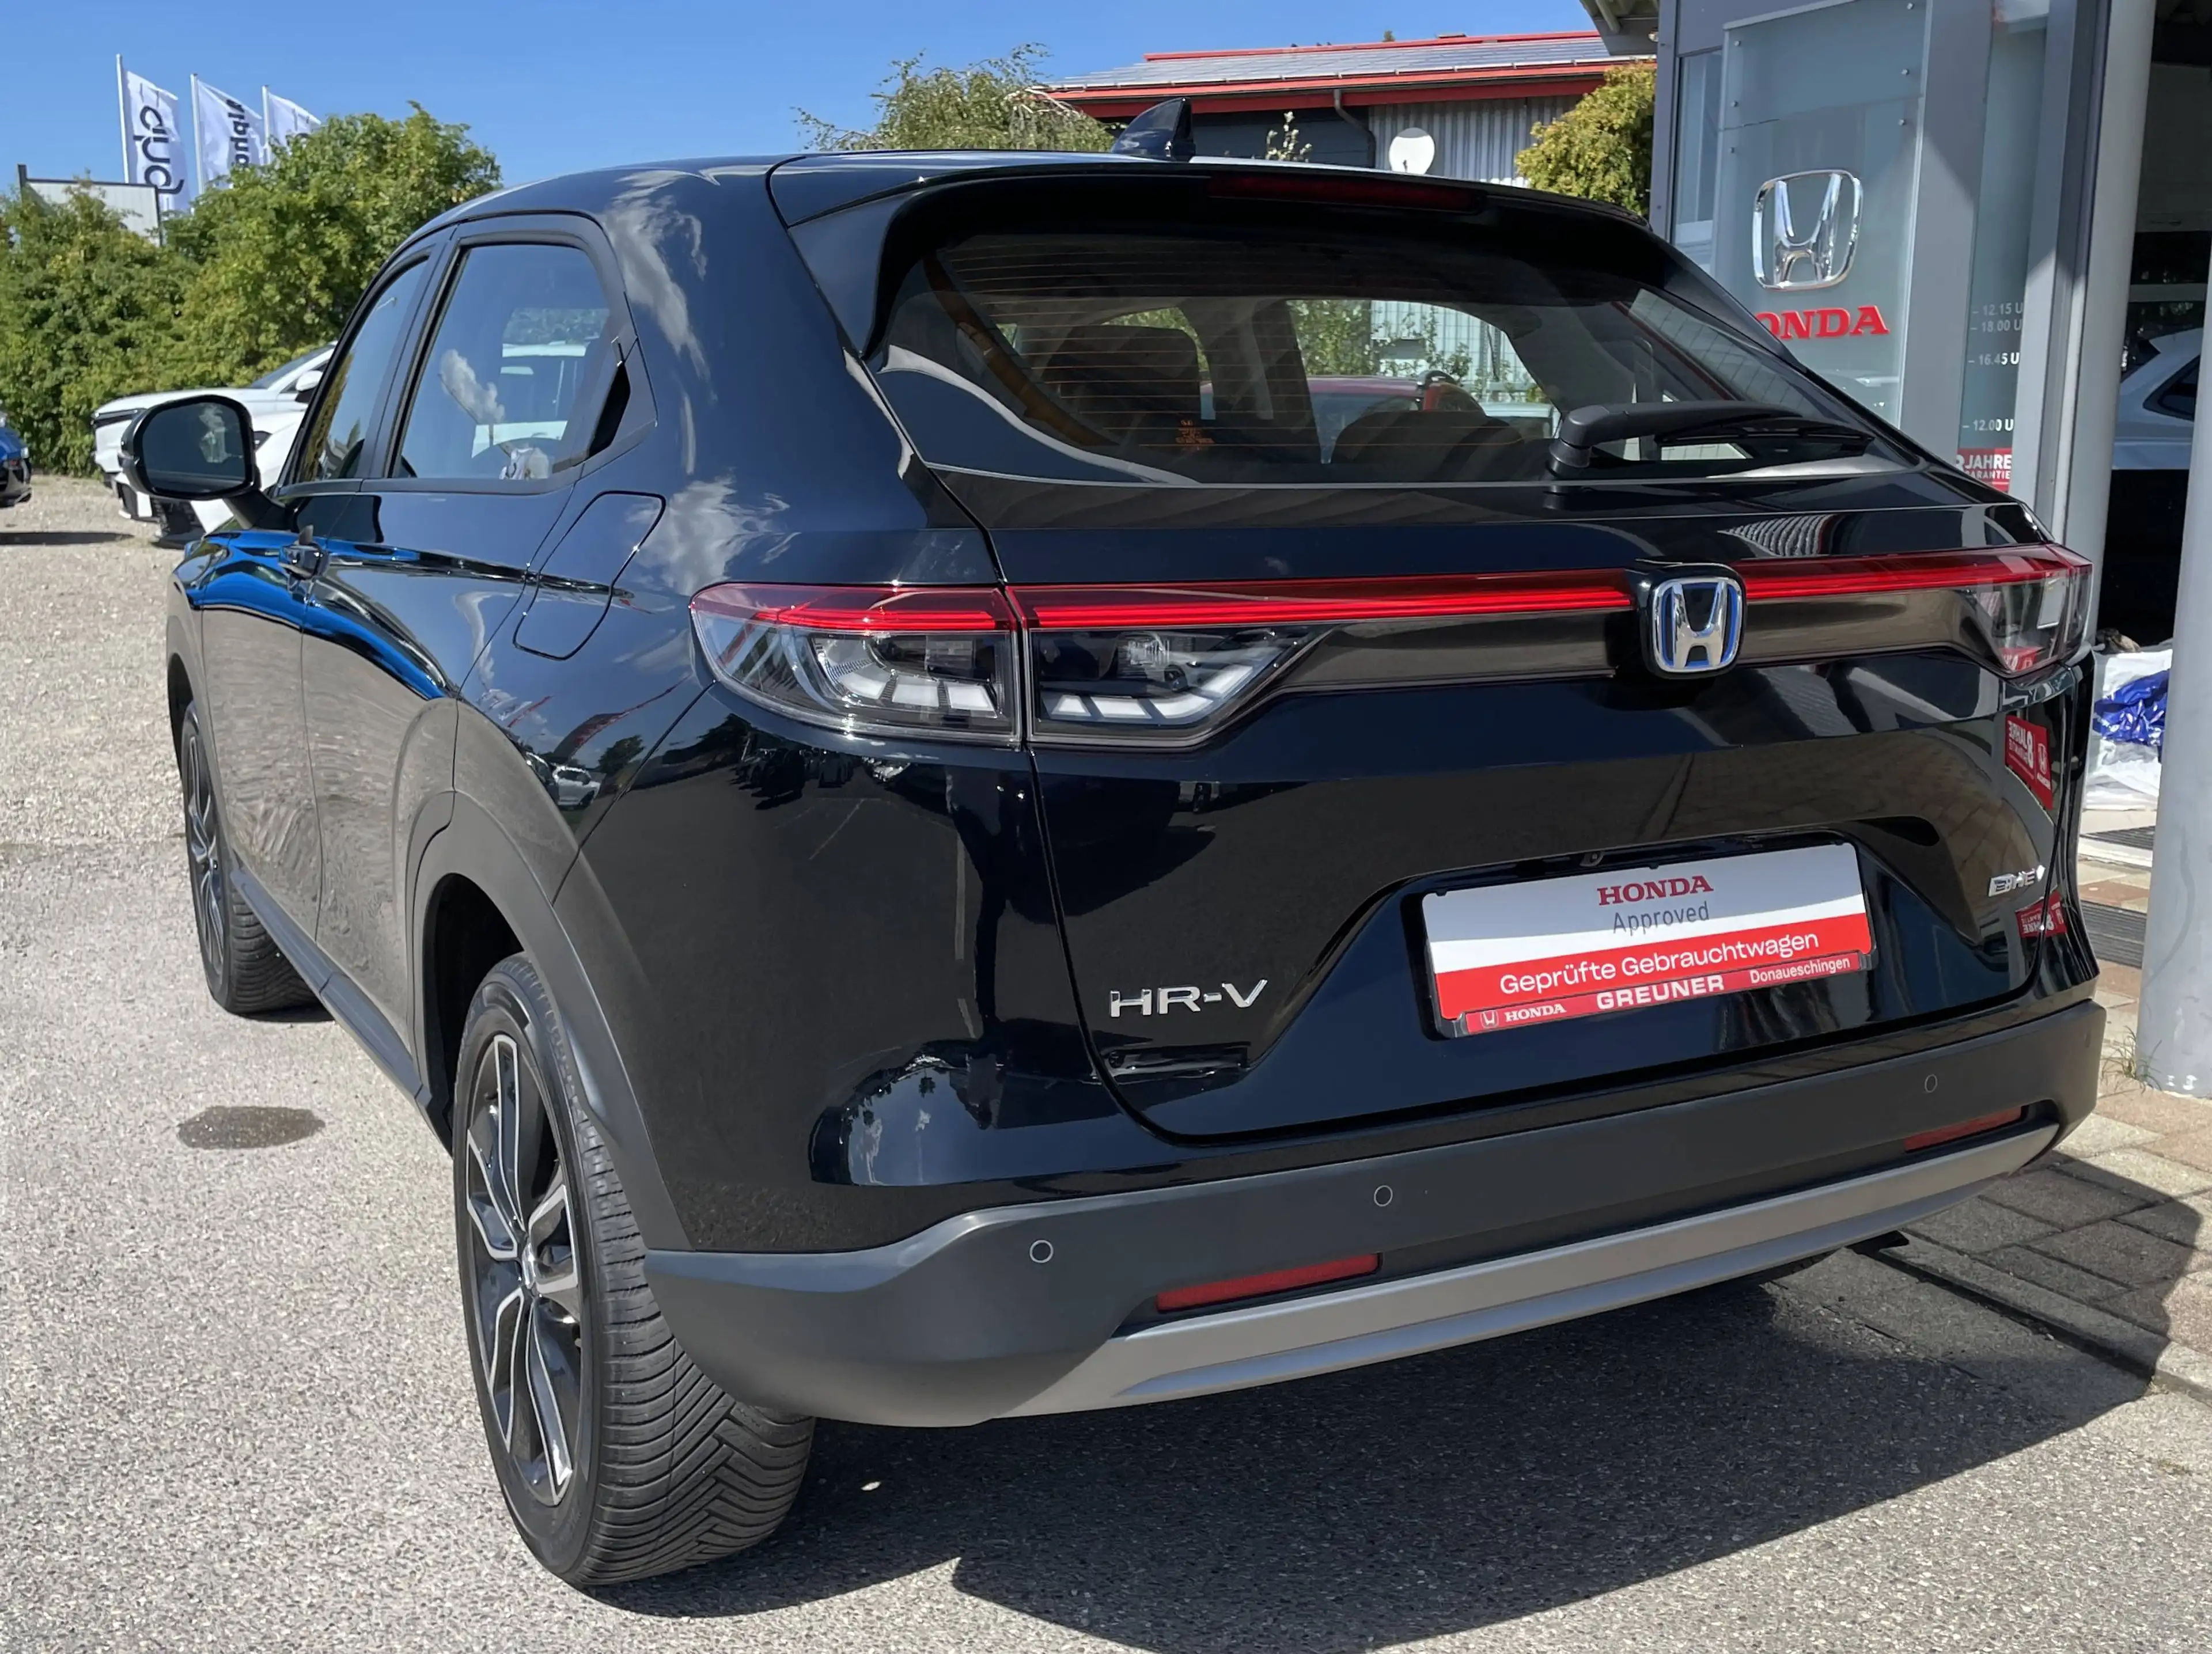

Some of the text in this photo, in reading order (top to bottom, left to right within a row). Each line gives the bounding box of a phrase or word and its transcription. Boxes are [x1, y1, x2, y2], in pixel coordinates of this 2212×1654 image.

[1983, 303, 2012, 316] 12.15
[1982, 319, 2011, 332] 18.00
[1979, 352, 2008, 365] 16.45
[1973, 419, 2003, 431] 12.00
[1965, 454, 2012, 470] JAHRE
[1597, 875, 1714, 906] HONDA
[1613, 901, 1710, 936] Approved
[1500, 932, 1819, 995] Geprüfte Gebrauchtwagen
[1109, 979, 1267, 1018] HR-V
[1505, 957, 1850, 1022] HONDA GREUNER Donaueschingen
